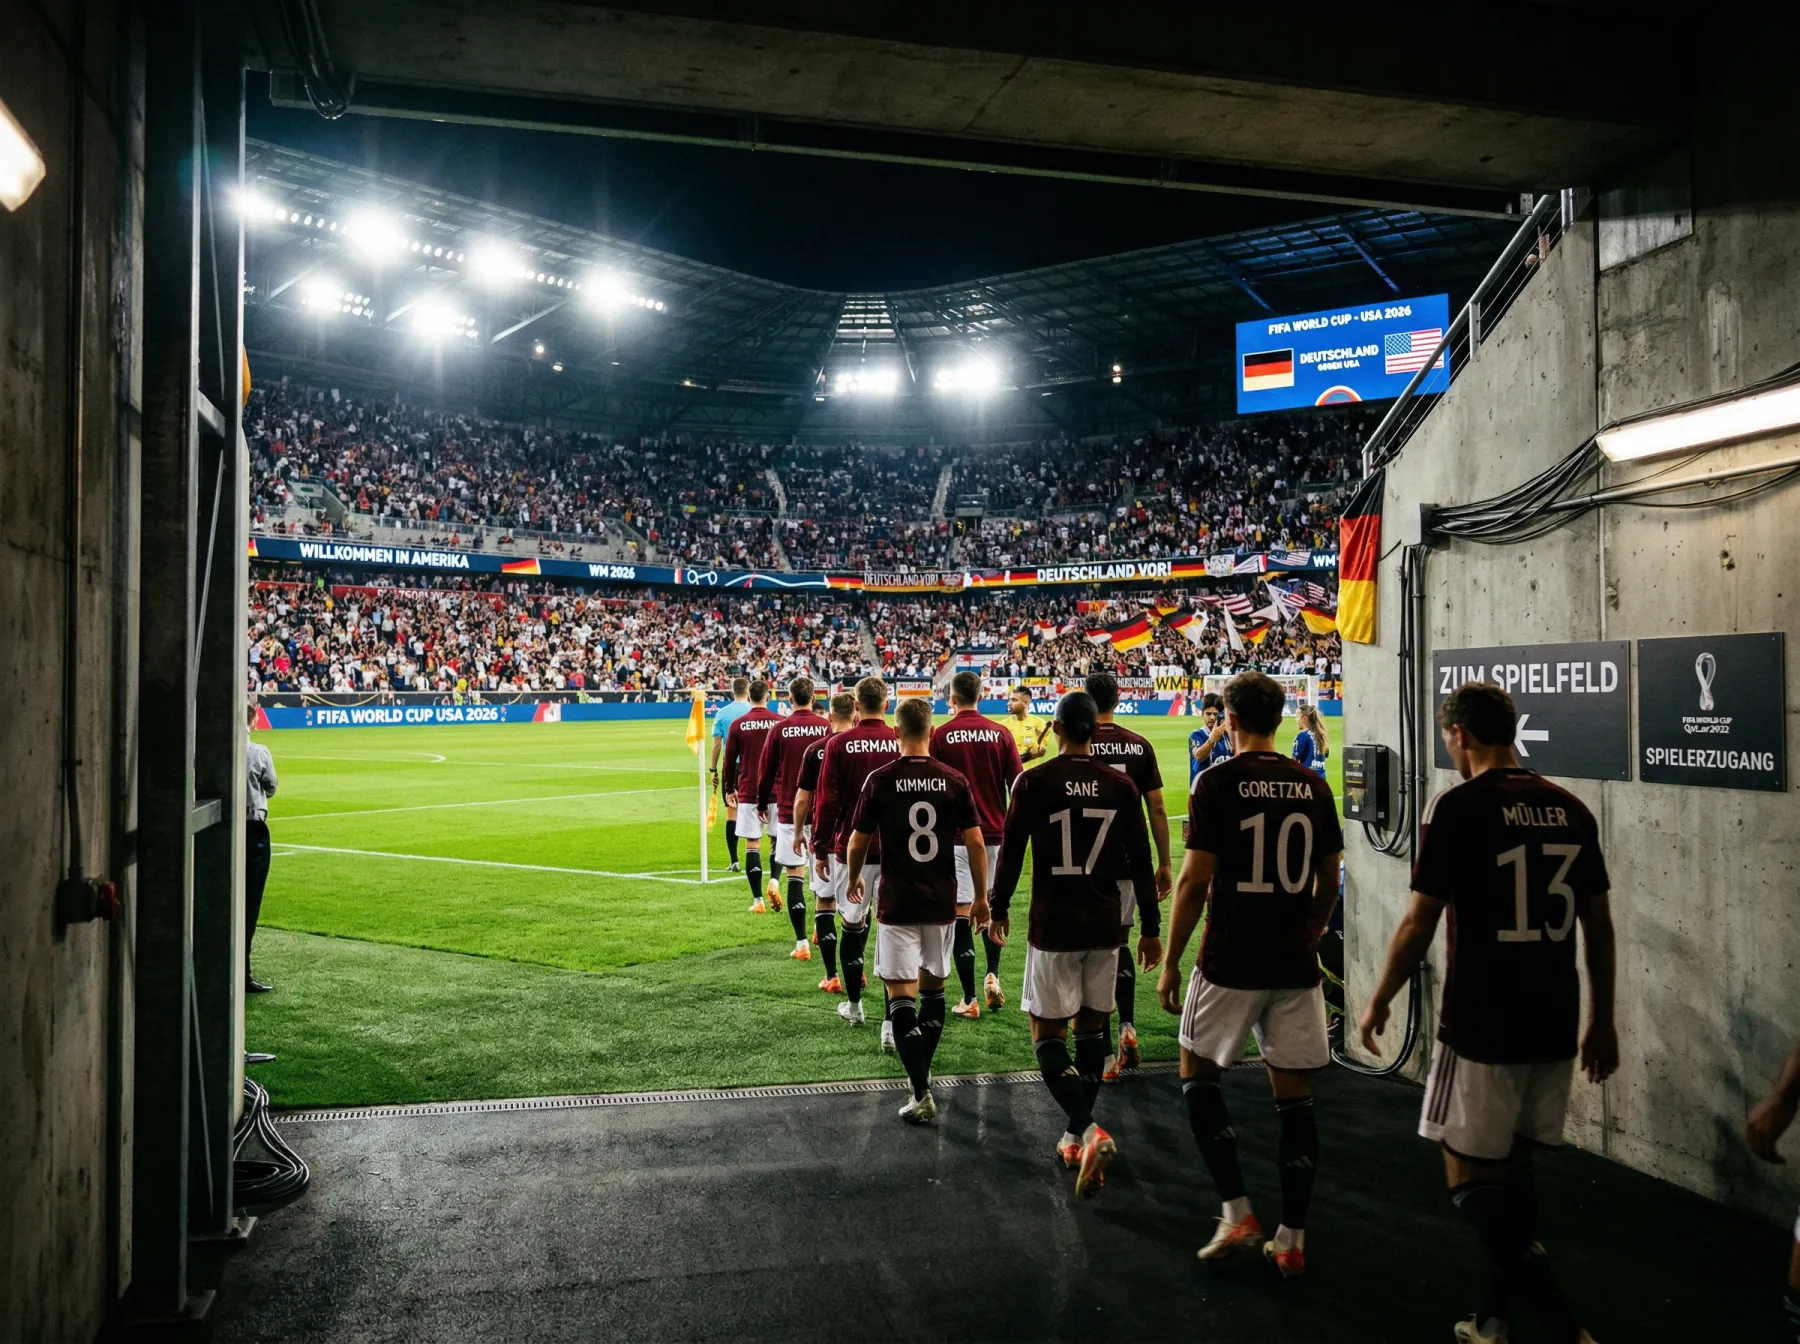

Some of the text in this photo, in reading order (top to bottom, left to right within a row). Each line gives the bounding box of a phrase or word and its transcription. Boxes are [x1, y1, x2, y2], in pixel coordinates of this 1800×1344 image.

[1268, 322, 1291, 336] FIFA
[1292, 316, 1329, 332] WORLD
[1330, 313, 1352, 327] CUP
[1360, 310, 1383, 323] USA
[1384, 305, 1412, 319] 2026
[1300, 344, 1380, 365] DEUTSCHLAND
[299, 542, 470, 569] WILLKOMMEN IN AMERIKA
[1312, 554, 1336, 568] WM
[588, 563, 636, 580] WM 2026
[864, 572, 919, 586] DEUTSCHLAND
[1036, 561, 1172, 583] DEUTSCHLAND VOR!
[1439, 660, 1618, 694] ZUM SPIELFELD
[317, 706, 498, 725] FIFA WORLD CUP USA 2026
[740, 719, 780, 731] GERMAN
[781, 725, 828, 738] GERMANY
[945, 729, 1001, 745] GERMANY
[845, 739, 899, 754] GERMAN
[1090, 742, 1144, 756] TSCHLAND
[1645, 747, 1774, 772] SPIELERZUGANG
[895, 777, 947, 793] KIMMICH
[1238, 780, 1314, 800] GORETZKA
[1501, 802, 1568, 827] MÜLLER
[908, 800, 939, 863] 8
[1049, 807, 1118, 876] 17
[1236, 811, 1314, 895] 10
[1496, 841, 1583, 943] 13
